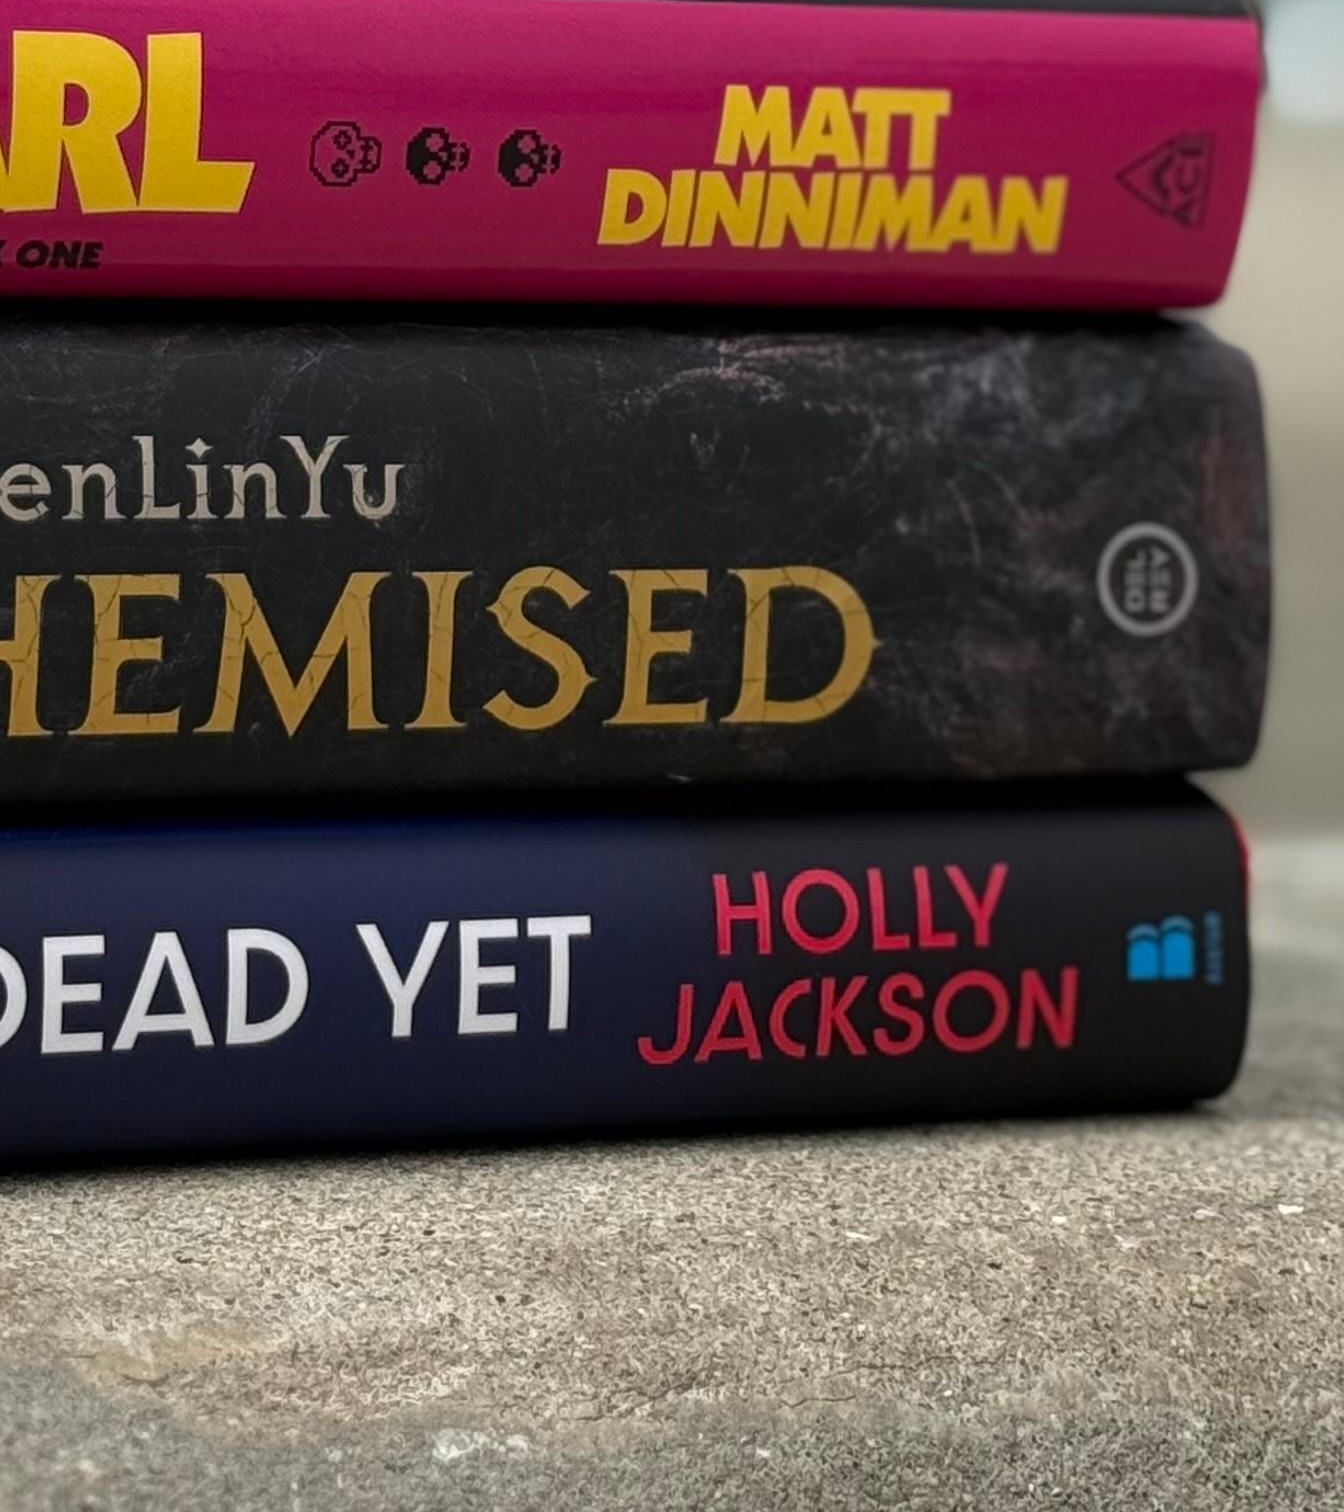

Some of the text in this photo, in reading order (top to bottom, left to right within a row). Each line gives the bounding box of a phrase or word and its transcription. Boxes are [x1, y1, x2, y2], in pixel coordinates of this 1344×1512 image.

[714, 85, 950, 170] MATT
[16, 241, 104, 270] ONE
[597, 168, 1068, 254] DINNIMAN
[712, 862, 1009, 956] HOLLY
[357, 914, 592, 1039] YET
[637, 966, 1079, 1065] JACKSON
